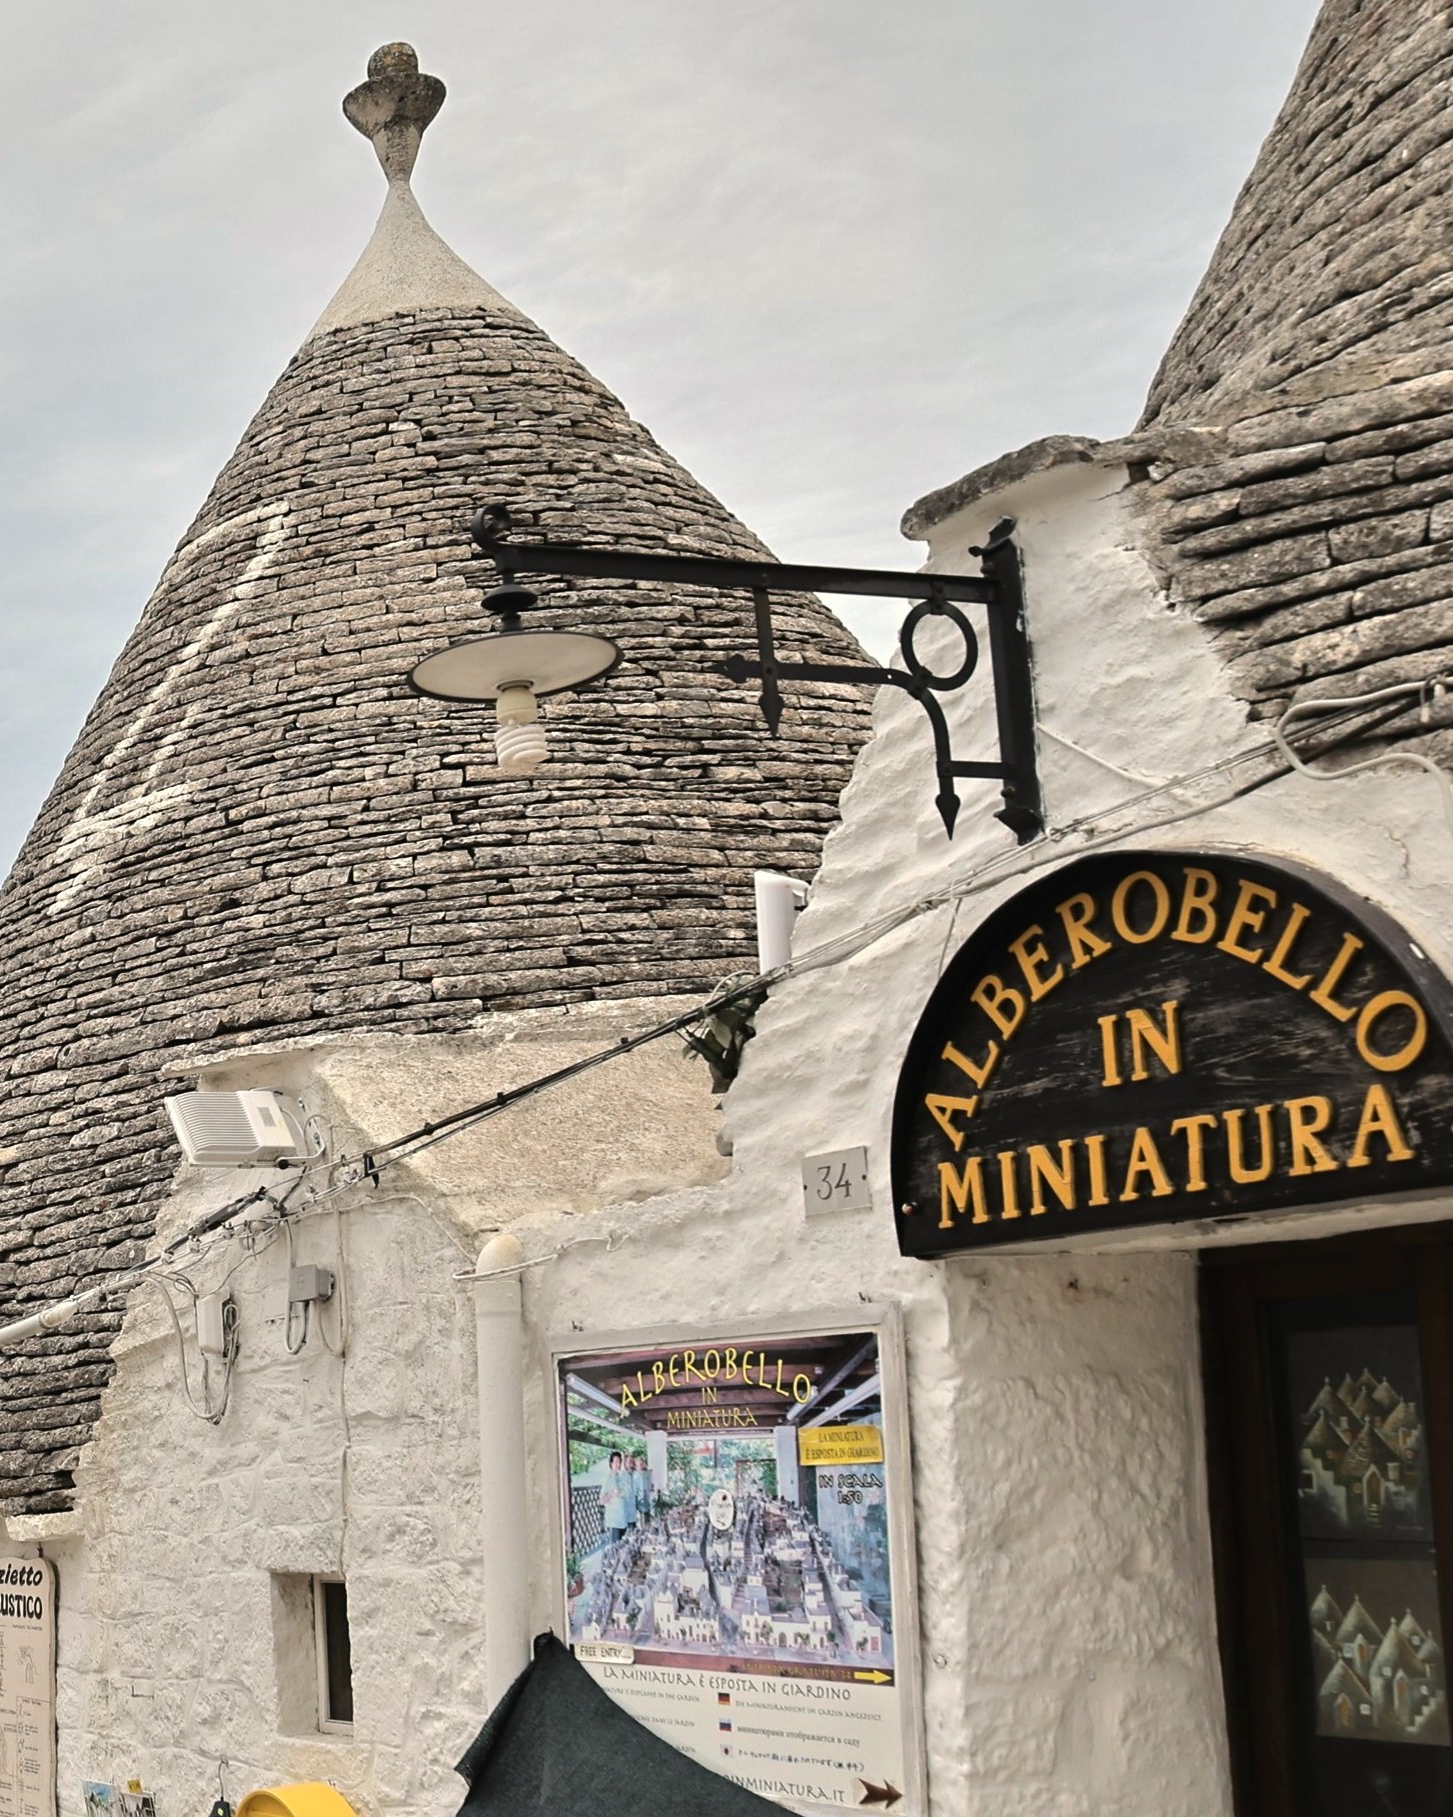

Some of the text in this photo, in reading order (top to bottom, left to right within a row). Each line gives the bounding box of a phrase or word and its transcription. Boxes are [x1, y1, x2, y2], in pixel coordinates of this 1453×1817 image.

[925, 867, 1427, 1152] ALBEROBELLO
[1098, 1000, 1183, 1088] IN
[938, 1083, 1416, 1229] MINIATURA
[817, 1163, 852, 1200] 34
[620, 1347, 812, 1419] ALBEROBELLO
[701, 1387, 717, 1405] IN
[667, 1406, 759, 1430] MINIATURA
[818, 1473, 883, 1489] IN SCALA
[837, 1490, 864, 1505] 1:50
[580, 1645, 597, 1657] FREE
[603, 1667, 852, 1701] LA MINIATURA È ESPOSTA IN GIARDINO
